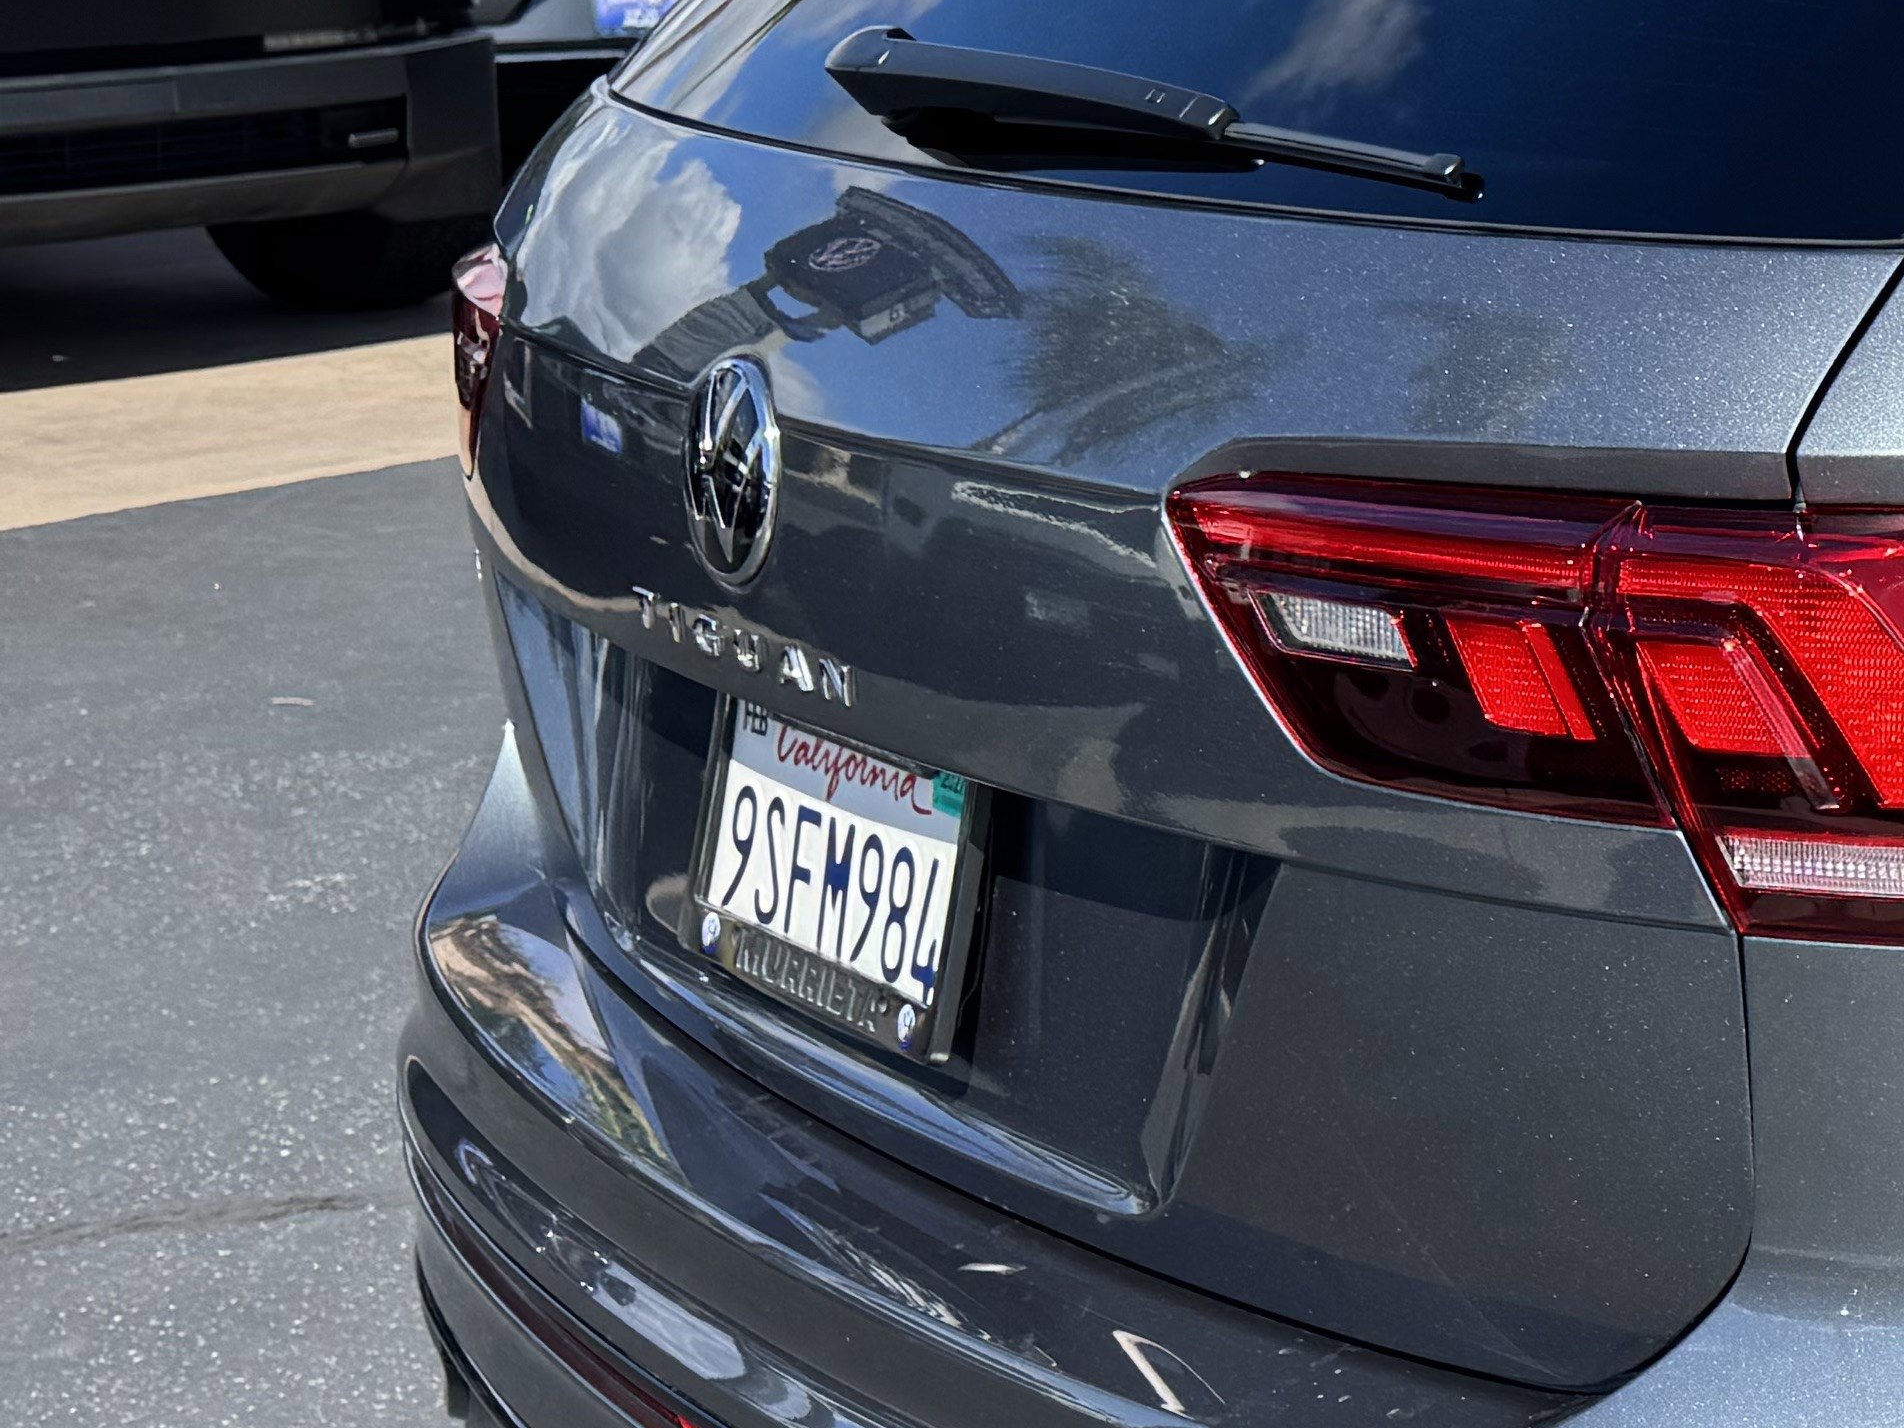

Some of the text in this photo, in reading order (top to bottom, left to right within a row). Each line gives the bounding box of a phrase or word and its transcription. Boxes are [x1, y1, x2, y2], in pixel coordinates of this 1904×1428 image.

[632, 585, 857, 708] TIGUAN
[777, 722, 932, 815] California
[721, 785, 940, 1006] 9SFM984
[736, 928, 876, 1033] MURRIETA
